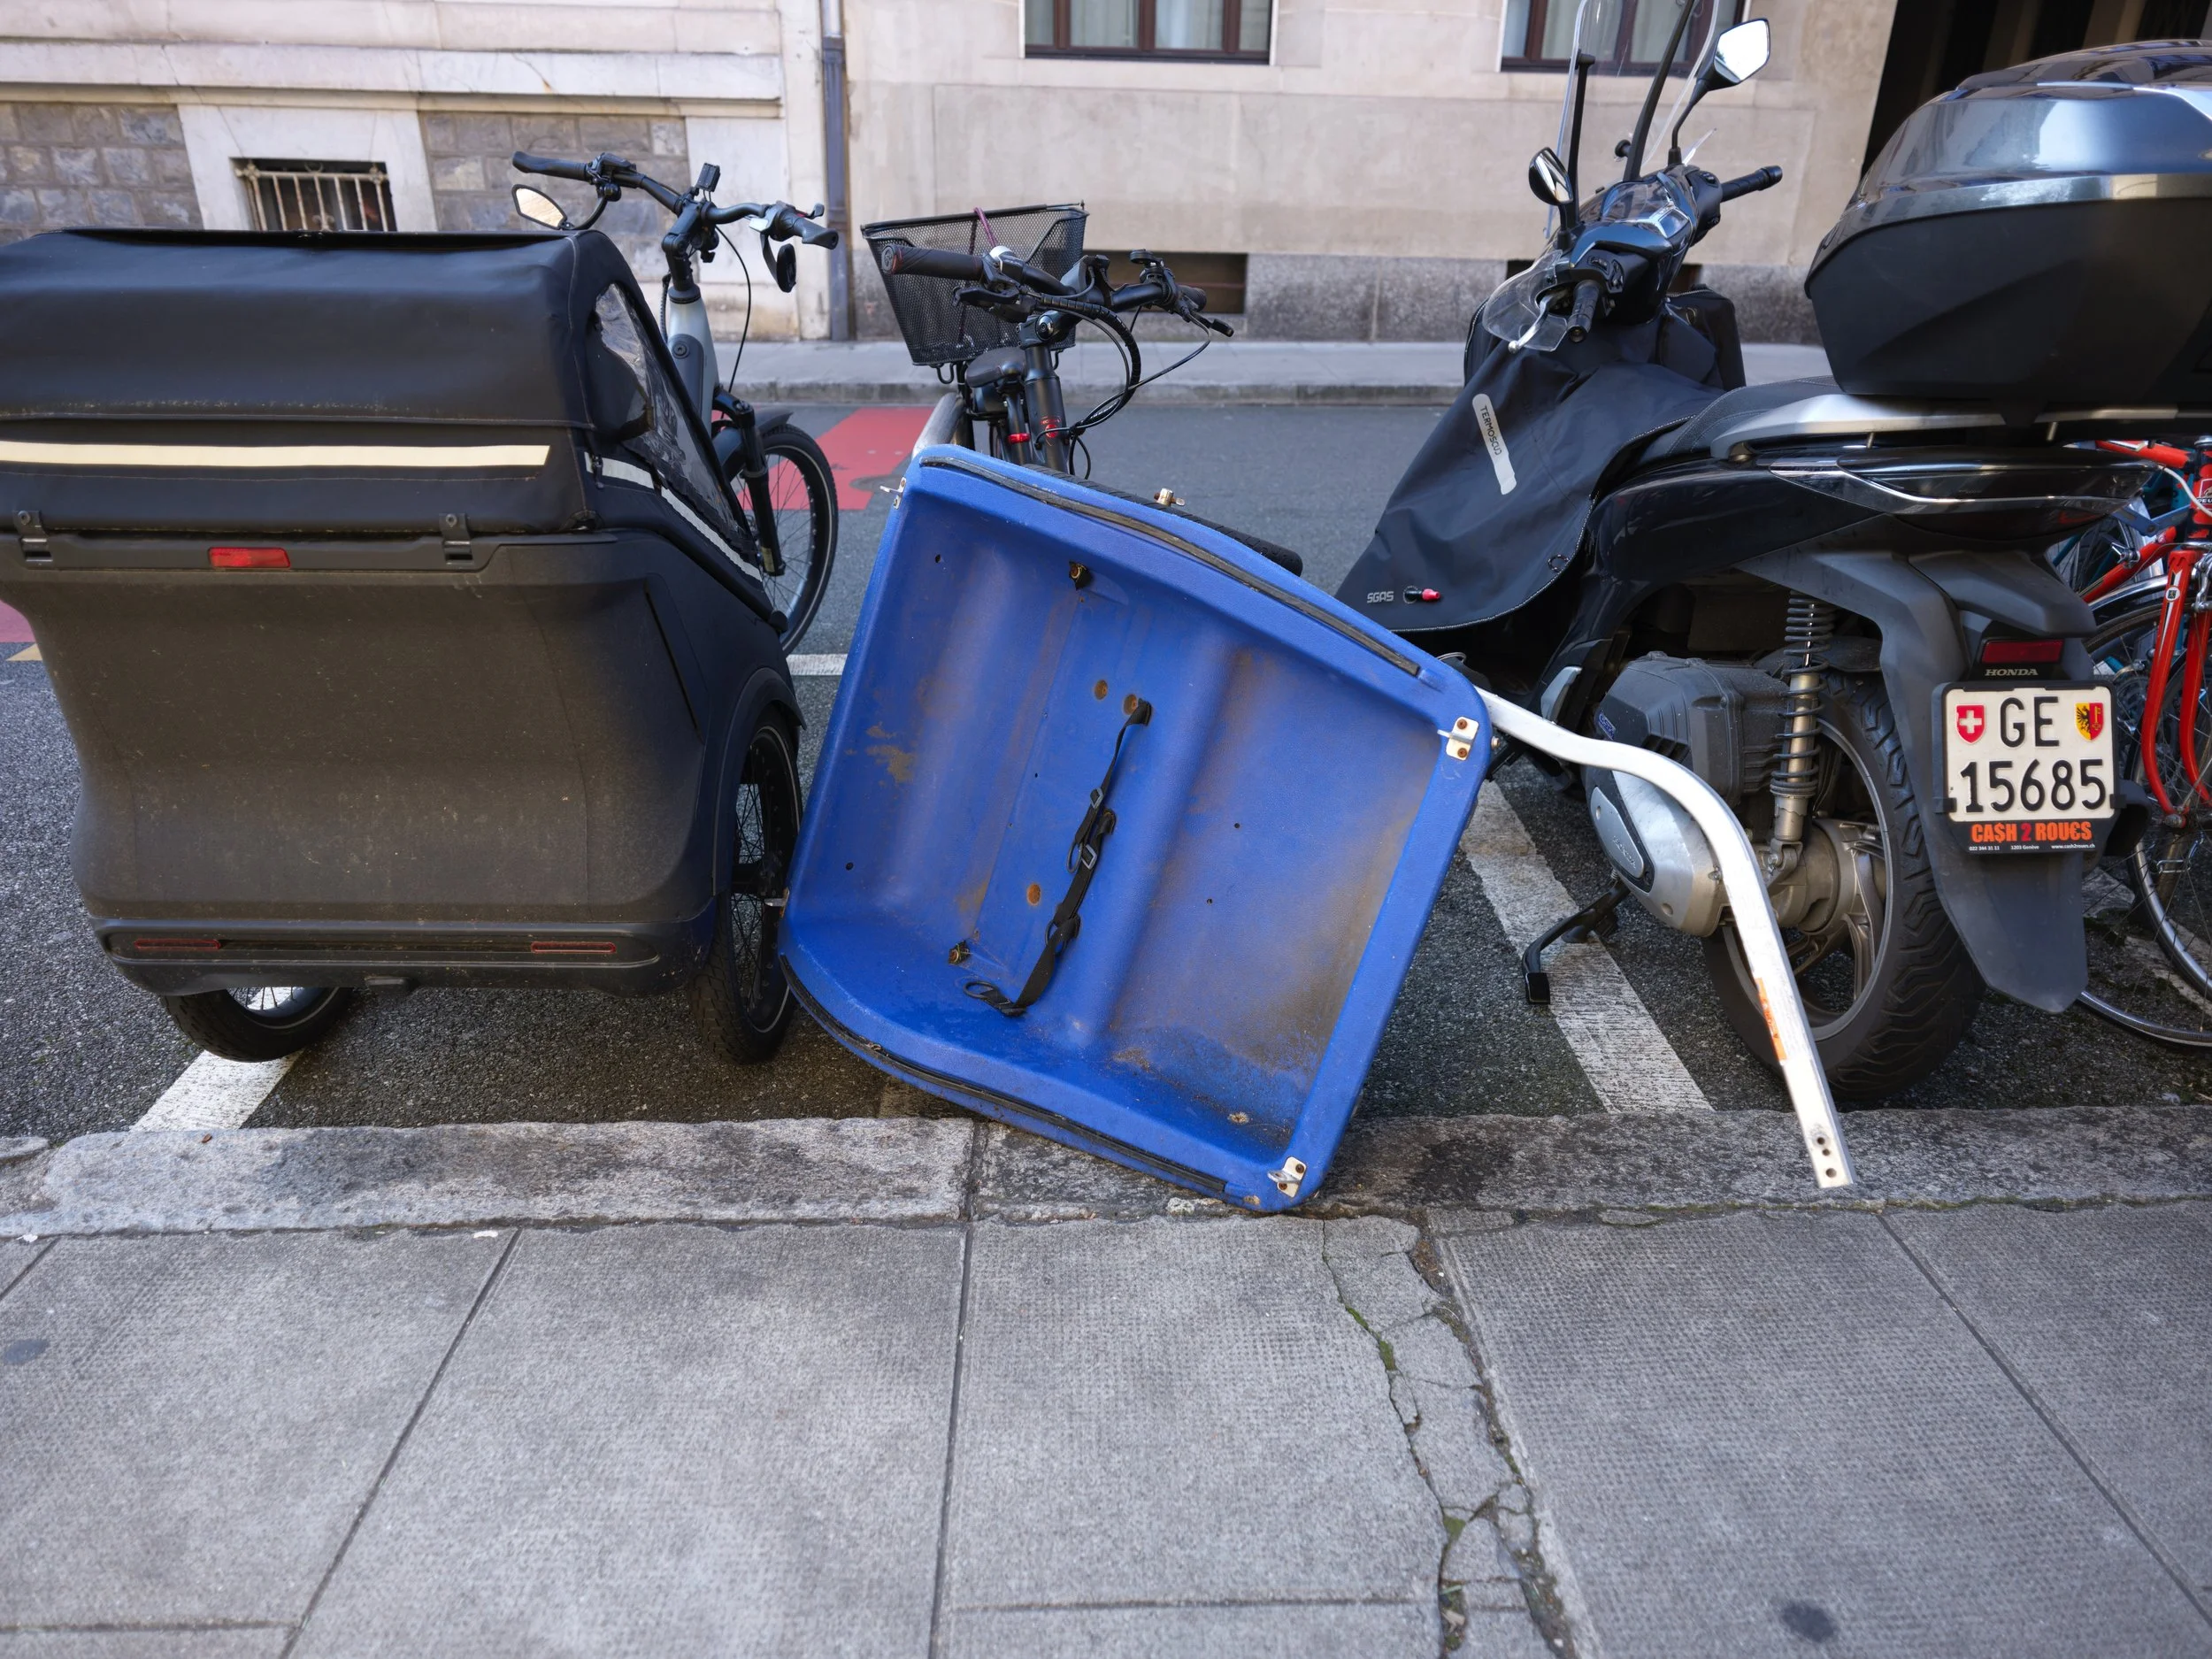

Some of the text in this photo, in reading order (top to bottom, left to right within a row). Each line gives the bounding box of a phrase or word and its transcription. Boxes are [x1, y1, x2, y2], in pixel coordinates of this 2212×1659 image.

[1479, 404, 1502, 456] TERMOSCUD
[1367, 590, 1394, 603] SGAS
[1985, 668, 2039, 677] HONDA
[2000, 695, 2060, 748] GE
[1960, 759, 2107, 813] 15685
[2021, 823, 2032, 842] 2
